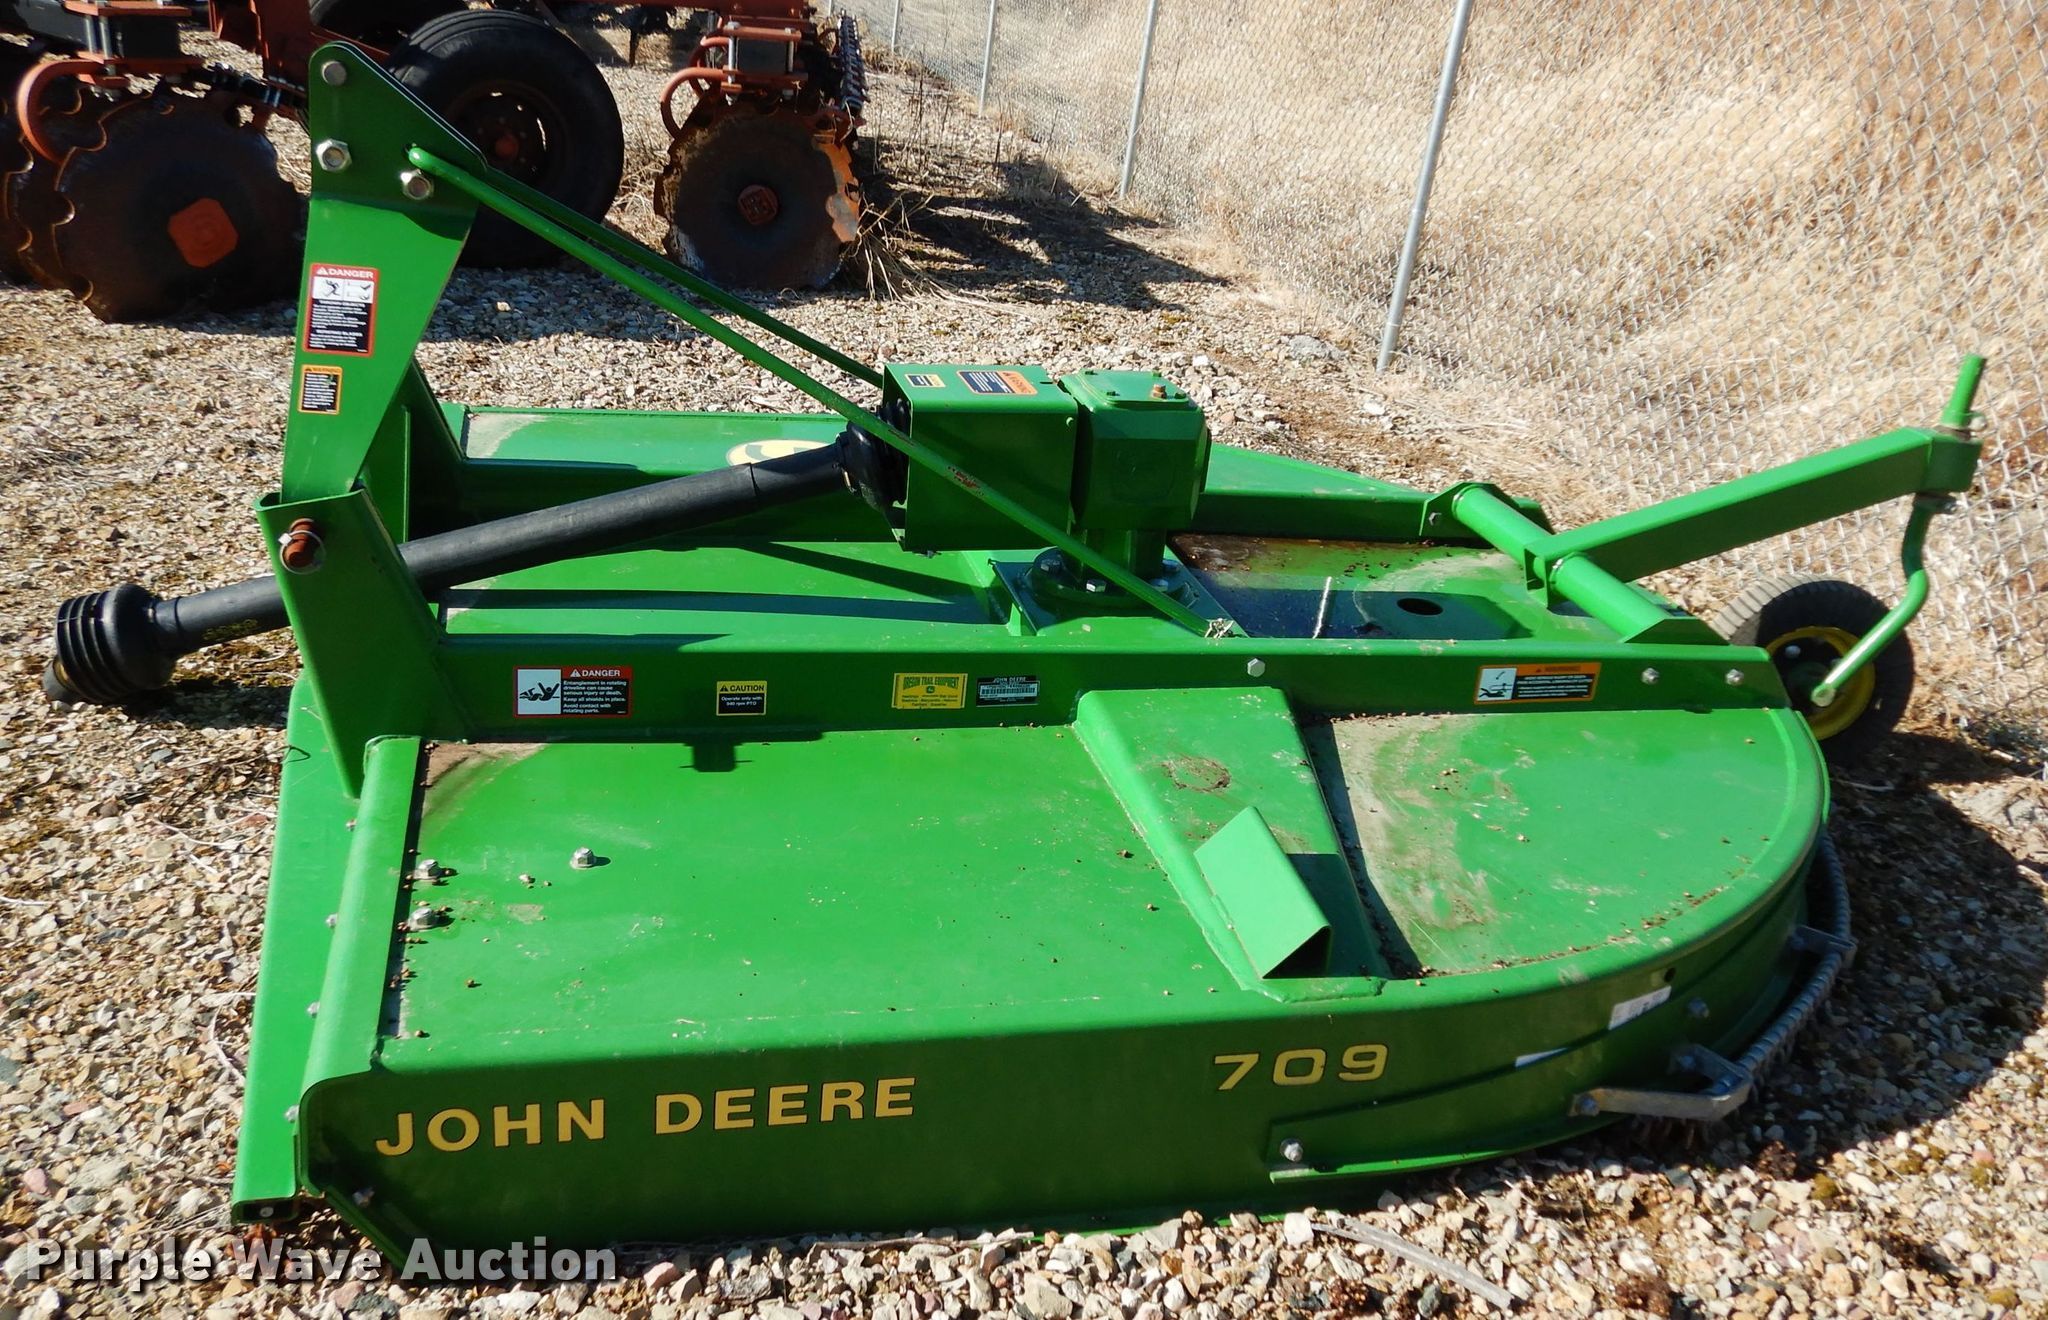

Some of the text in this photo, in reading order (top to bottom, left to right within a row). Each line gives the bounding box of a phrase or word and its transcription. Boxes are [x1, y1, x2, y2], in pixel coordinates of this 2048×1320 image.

[328, 268, 374, 279] DANGER
[581, 669, 621, 677] DANGER
[1213, 1043, 1389, 1091] 709
[375, 1076, 916, 1157] JOHN DEERE
